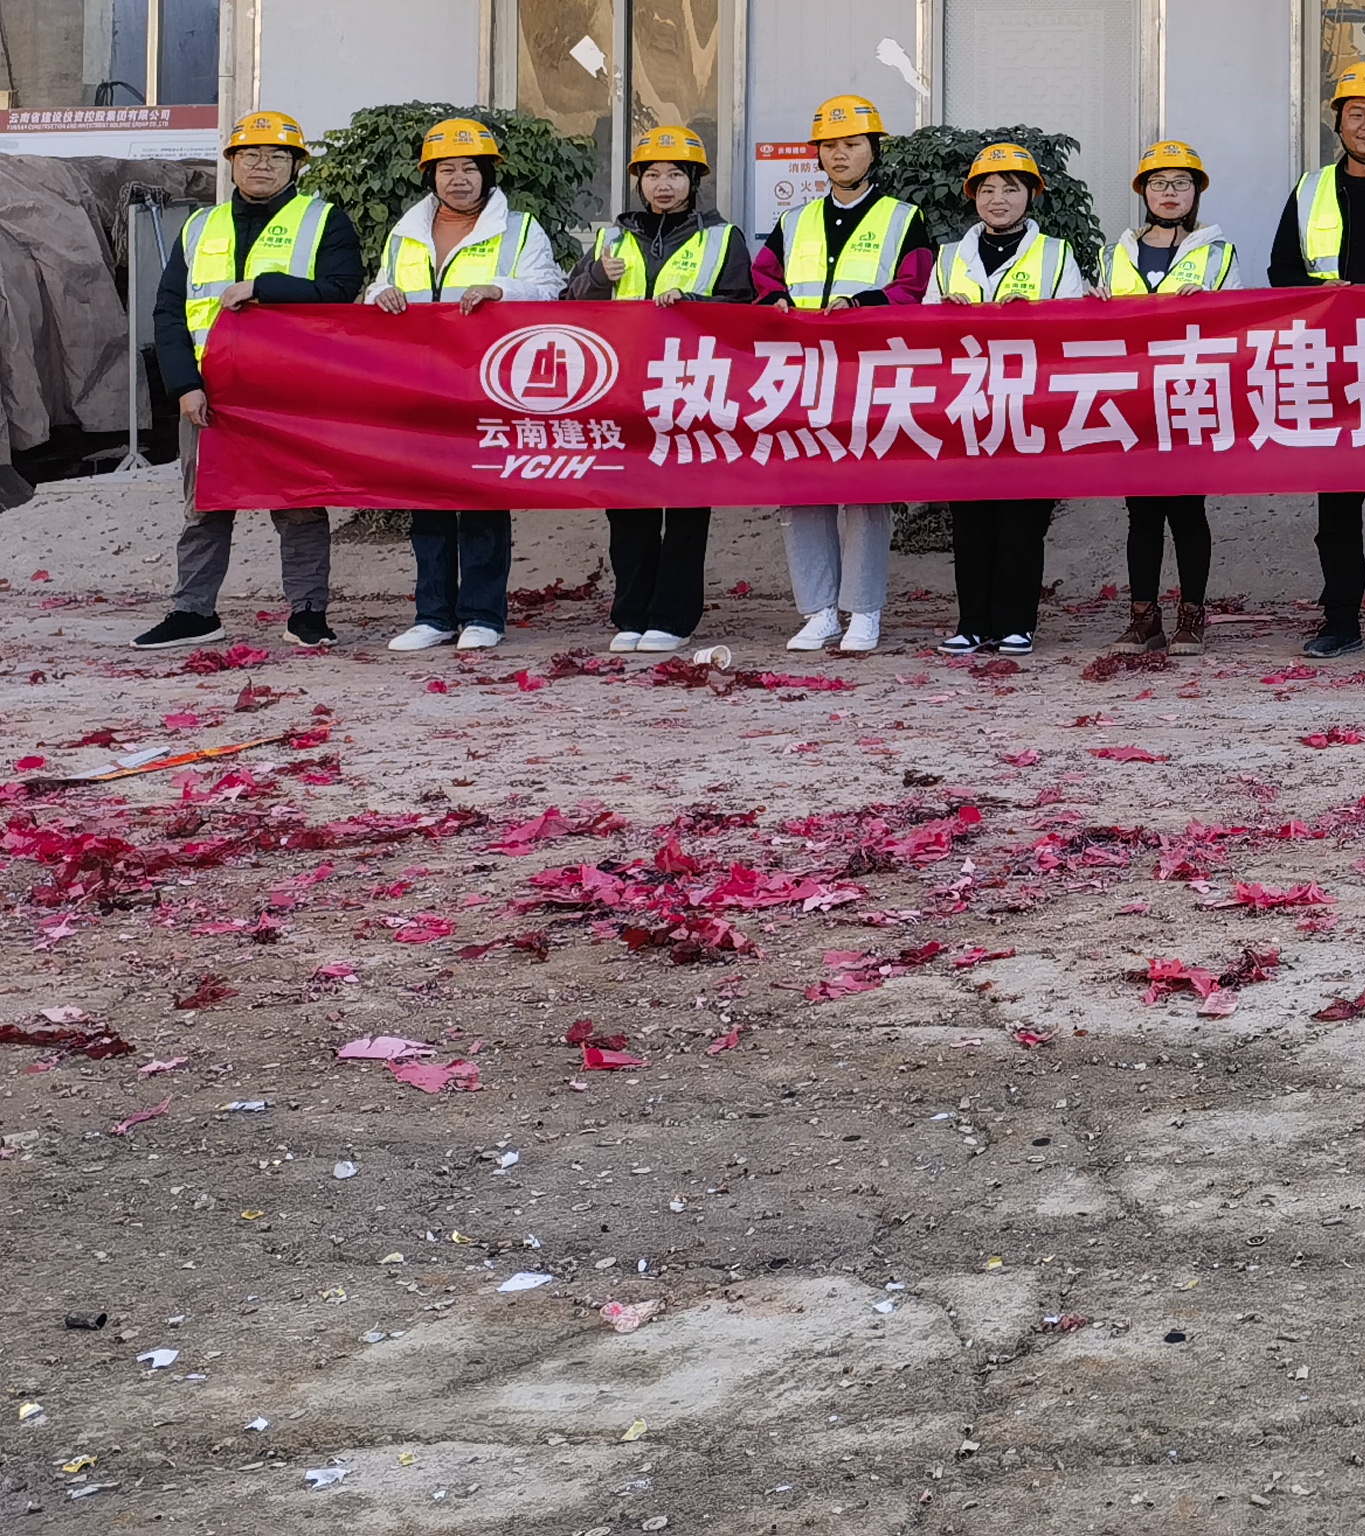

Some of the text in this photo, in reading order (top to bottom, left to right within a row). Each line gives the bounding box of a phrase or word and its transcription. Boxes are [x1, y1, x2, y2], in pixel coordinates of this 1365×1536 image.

[9, 109, 171, 124] 云南省建设投资控股集团有限公司
[476, 417, 626, 452] 云南建投
[498, 454, 599, 481] YCIH
